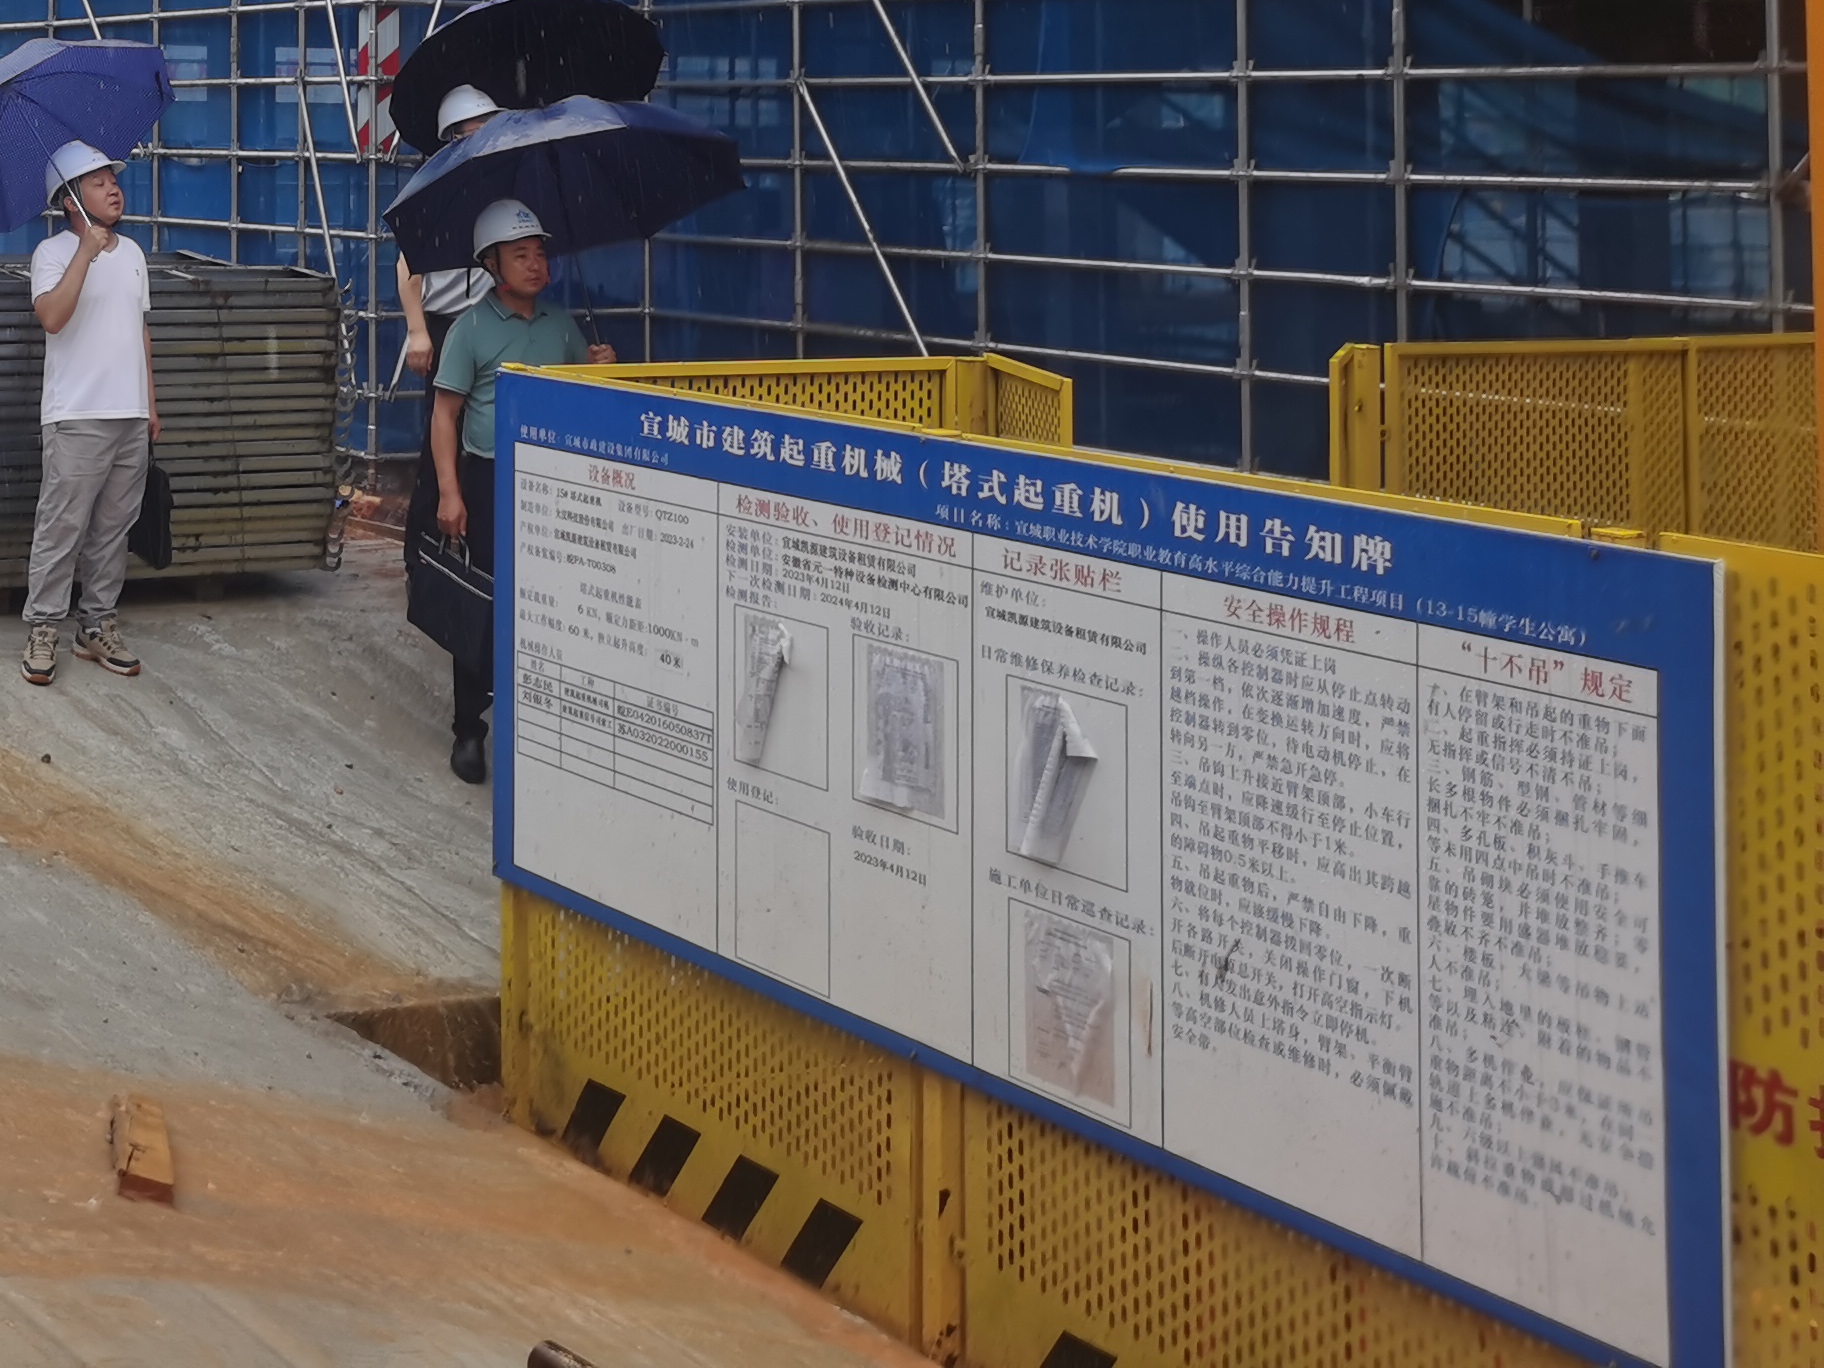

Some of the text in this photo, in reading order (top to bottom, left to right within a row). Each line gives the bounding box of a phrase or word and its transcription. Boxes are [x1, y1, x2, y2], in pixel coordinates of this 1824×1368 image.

[588, 463, 635, 490] 设备概况
[735, 492, 956, 559] 检测验收、使用登记情况
[1002, 546, 1121, 595] 记录张贴栏
[1223, 593, 1355, 645] 安全操作规程
[530, 658, 544, 673] 姓名
[1580, 666, 1632, 704] 规定
